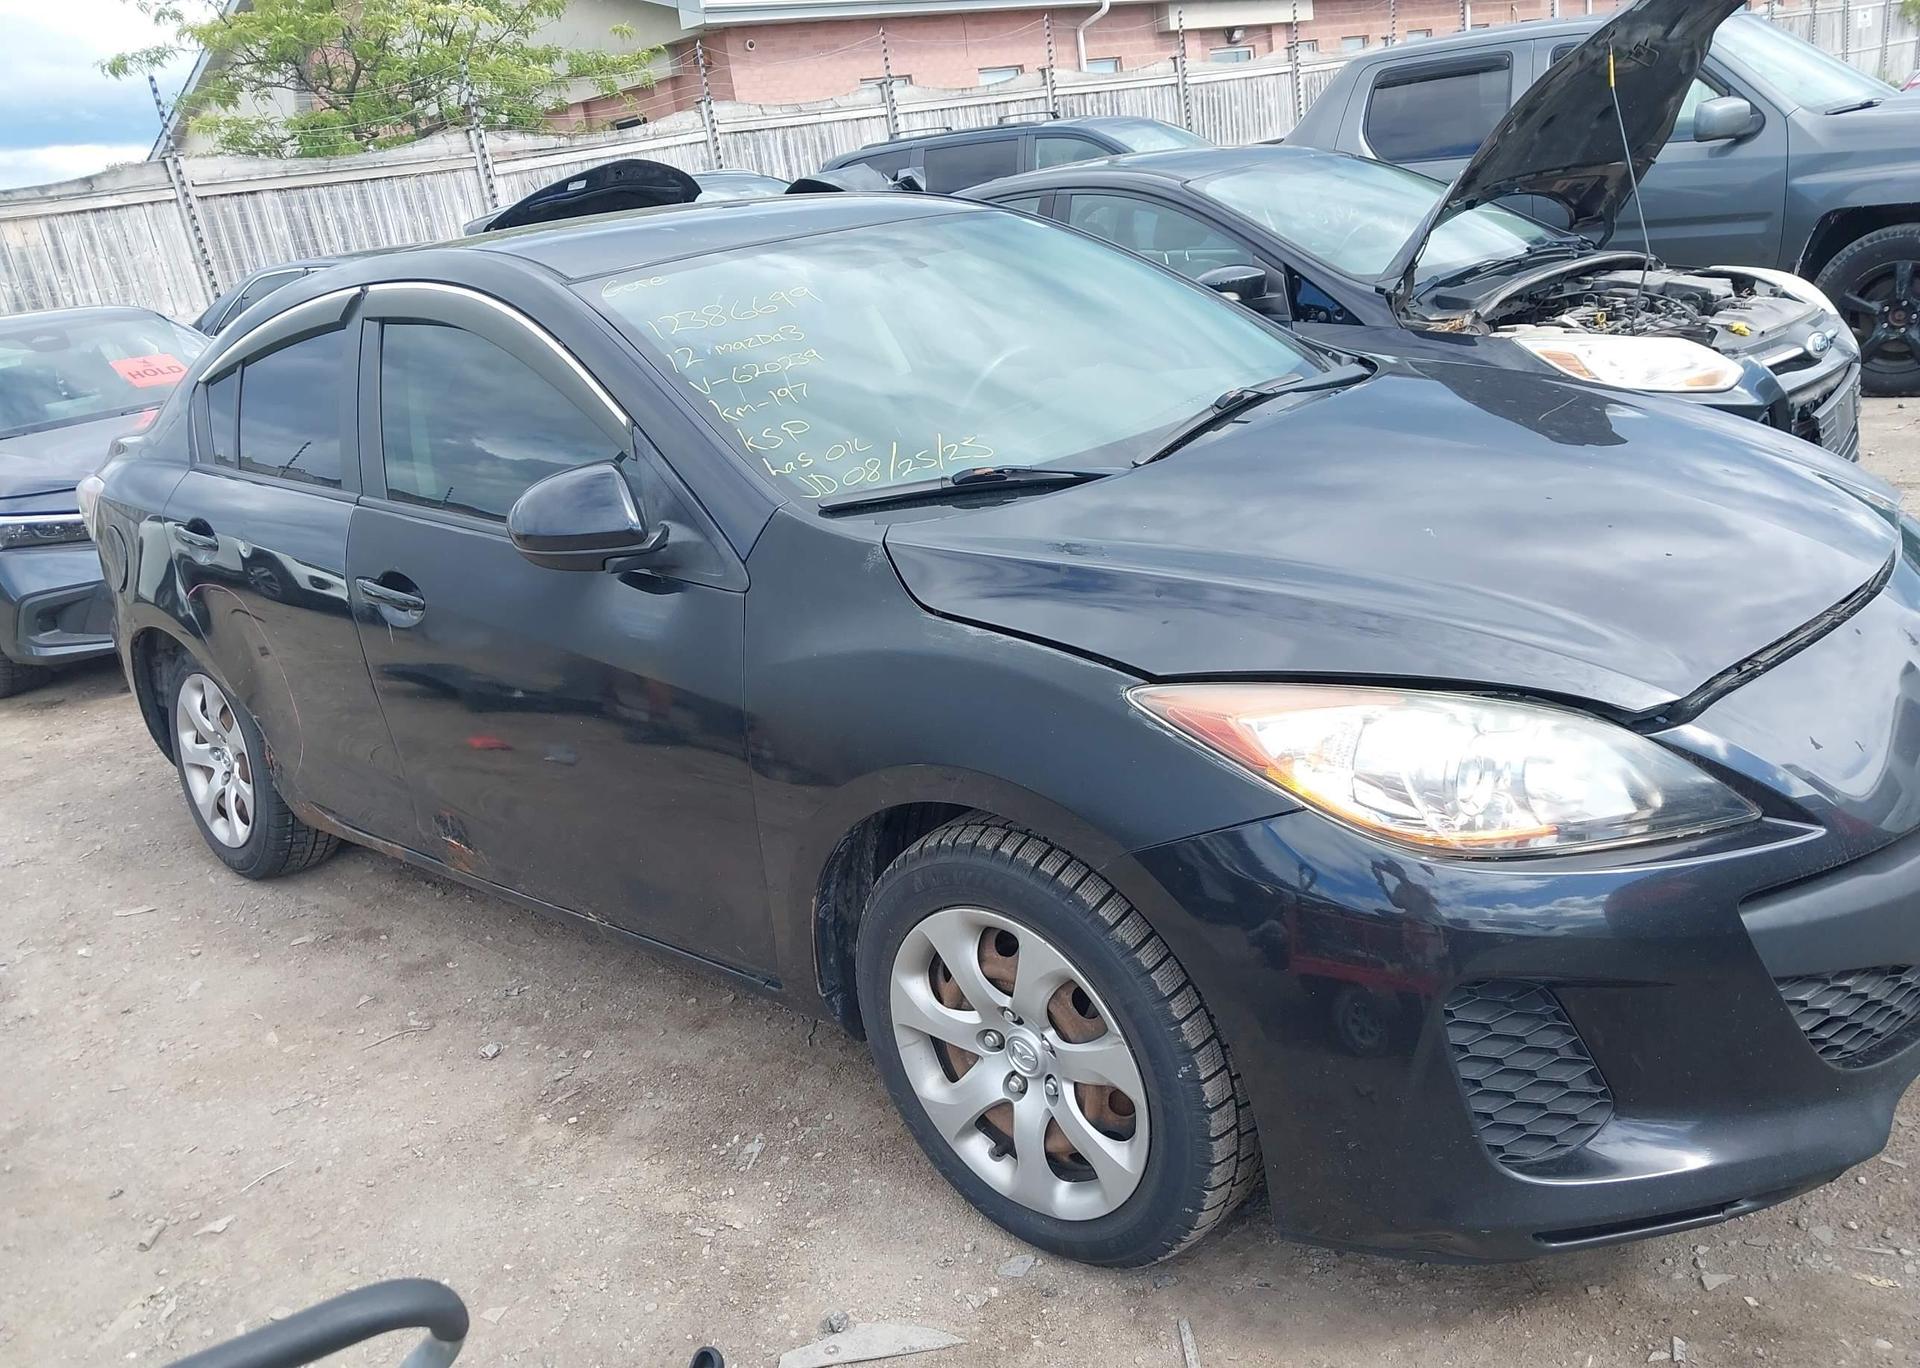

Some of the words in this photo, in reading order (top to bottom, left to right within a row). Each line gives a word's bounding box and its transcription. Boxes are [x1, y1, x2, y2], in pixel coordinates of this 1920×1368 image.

[648, 286, 823, 340] 12386699
[127, 365, 185, 380] HOLD
[666, 347, 705, 374] 12
